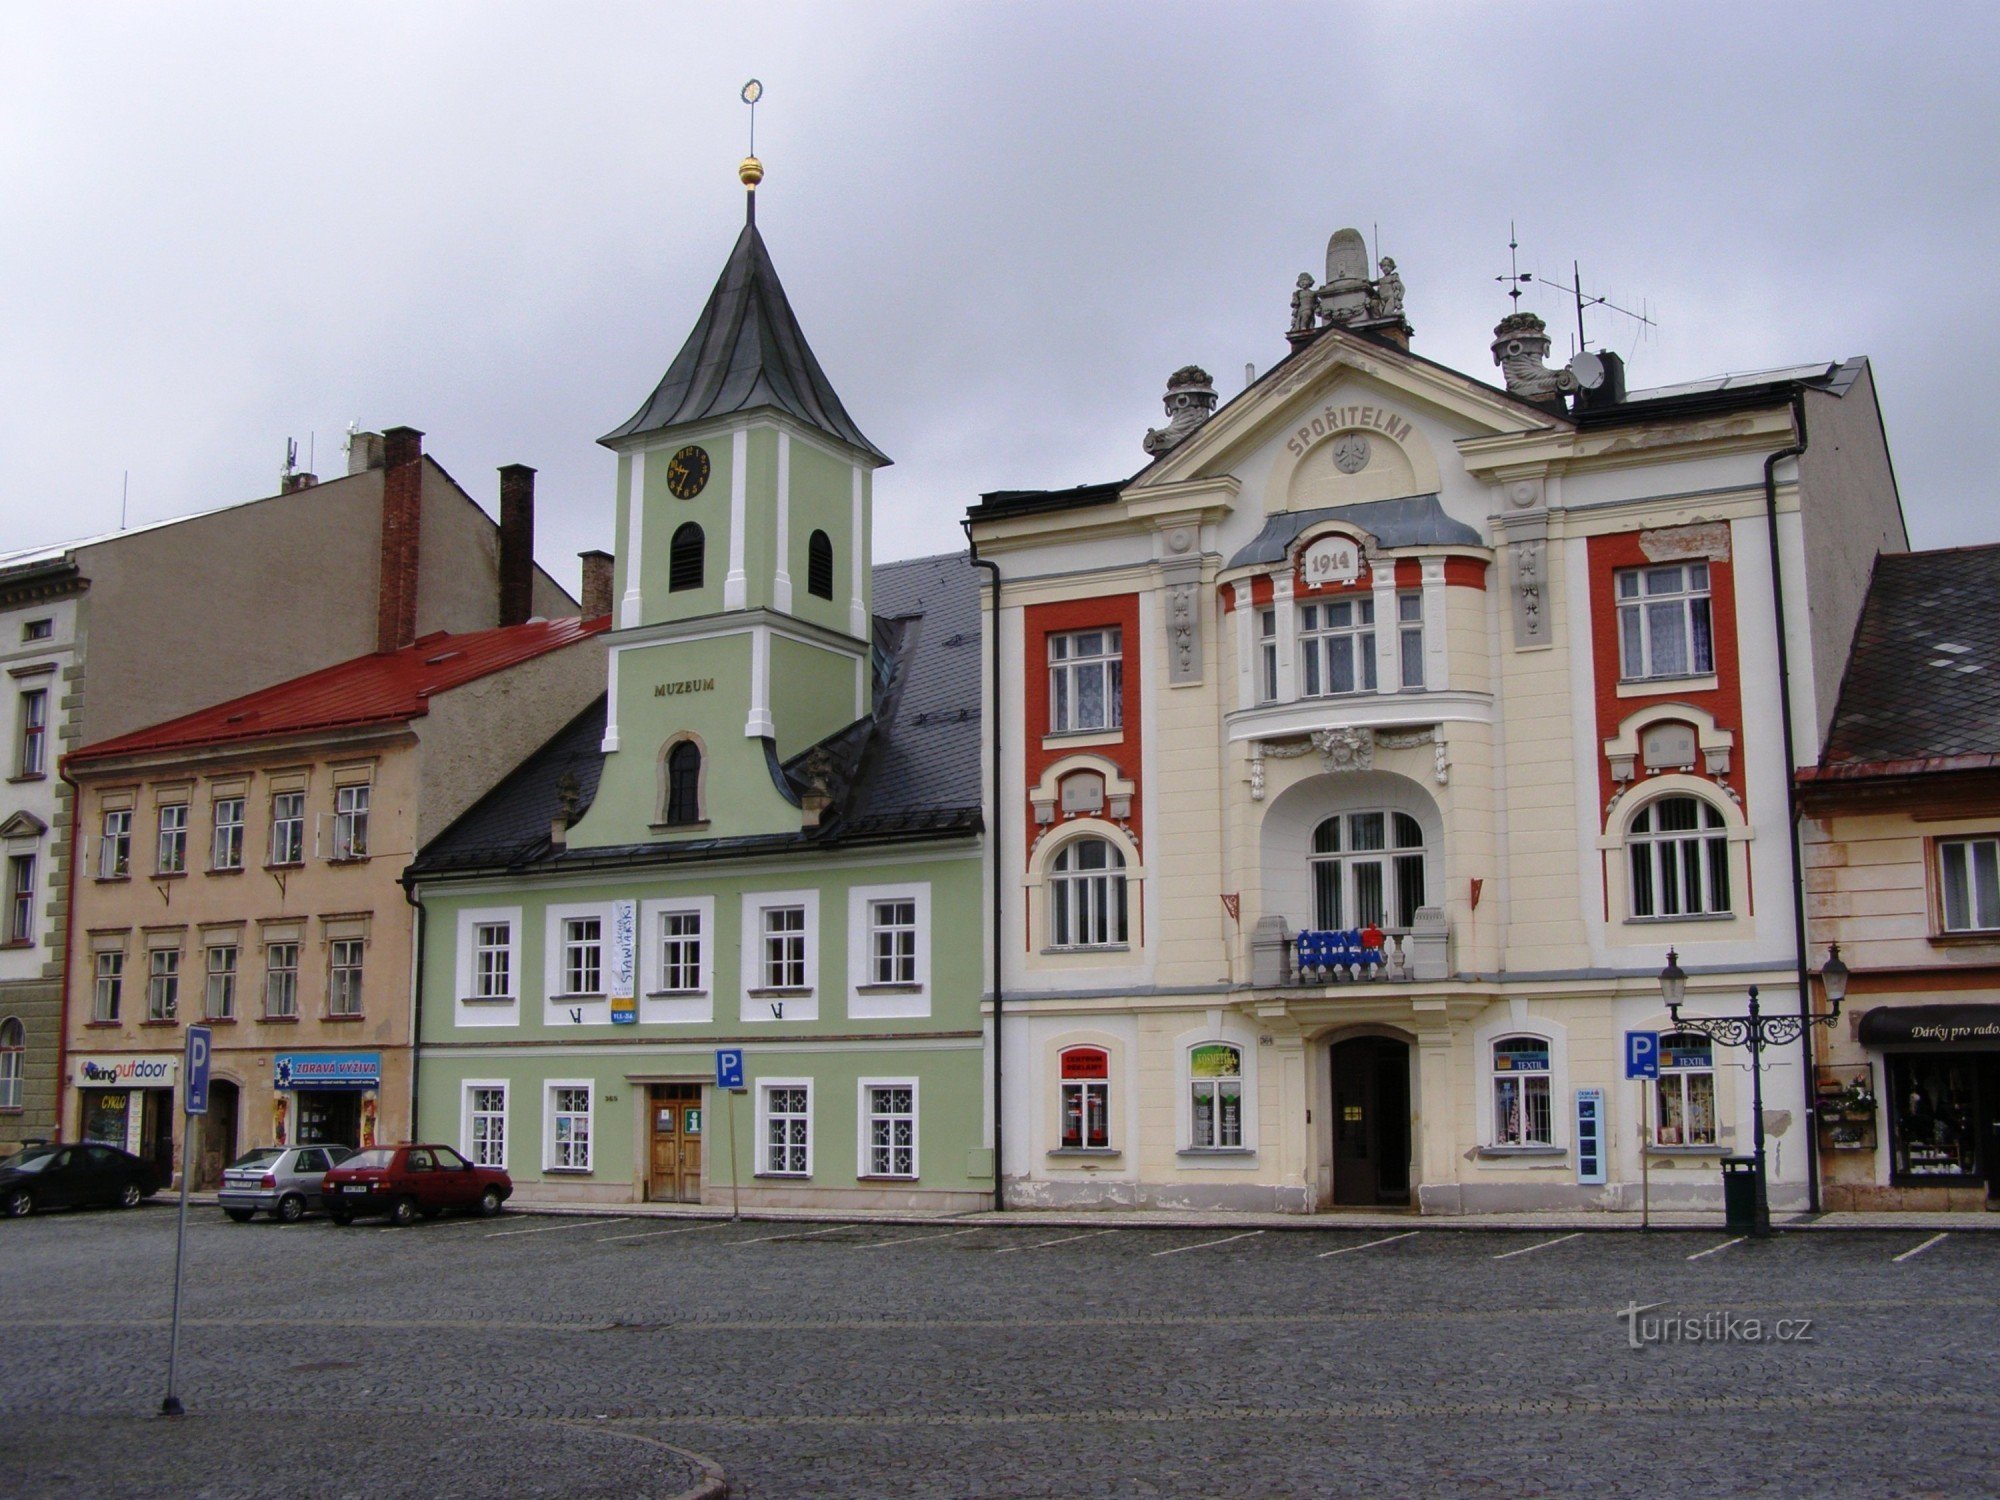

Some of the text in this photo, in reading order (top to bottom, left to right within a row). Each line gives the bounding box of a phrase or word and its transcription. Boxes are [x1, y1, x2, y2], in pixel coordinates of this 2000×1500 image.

[1287, 406, 1412, 457] SPOŘITELNA
[1312, 550, 1350, 574] 1914
[654, 678, 714, 697] MUZEUM
[1912, 1024, 1949, 1041] Dárky
[1951, 1027, 1970, 1041] pro
[1632, 1036, 1652, 1064] P
[115, 1060, 168, 1078] outdoor
[191, 1037, 206, 1085] P
[296, 1061, 335, 1074] ZDRAVÁ
[721, 1053, 737, 1076] P
[1517, 1061, 1543, 1071] TEXTIL
[1680, 1057, 1706, 1066] TEXTIL
